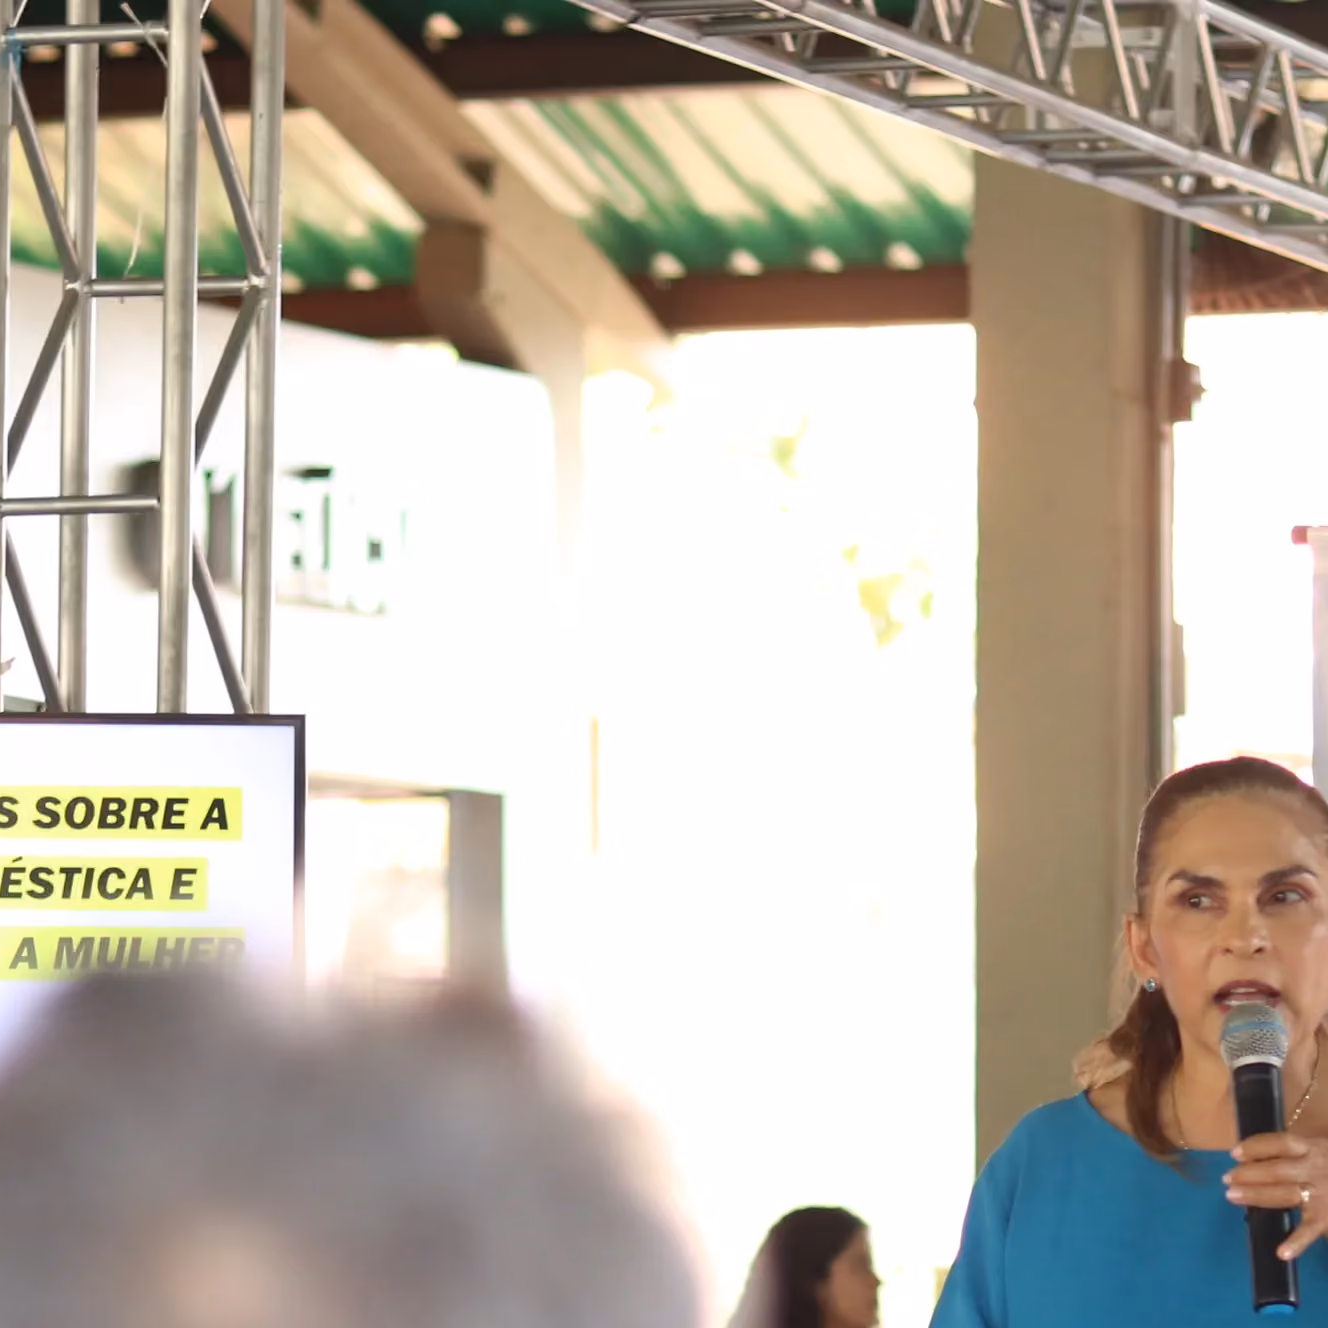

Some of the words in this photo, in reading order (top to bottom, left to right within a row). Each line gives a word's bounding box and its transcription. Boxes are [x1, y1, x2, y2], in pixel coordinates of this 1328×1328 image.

[31, 797, 188, 831] SOBRE
[200, 798, 230, 831] A
[170, 867, 198, 900] E
[9, 937, 38, 969] A
